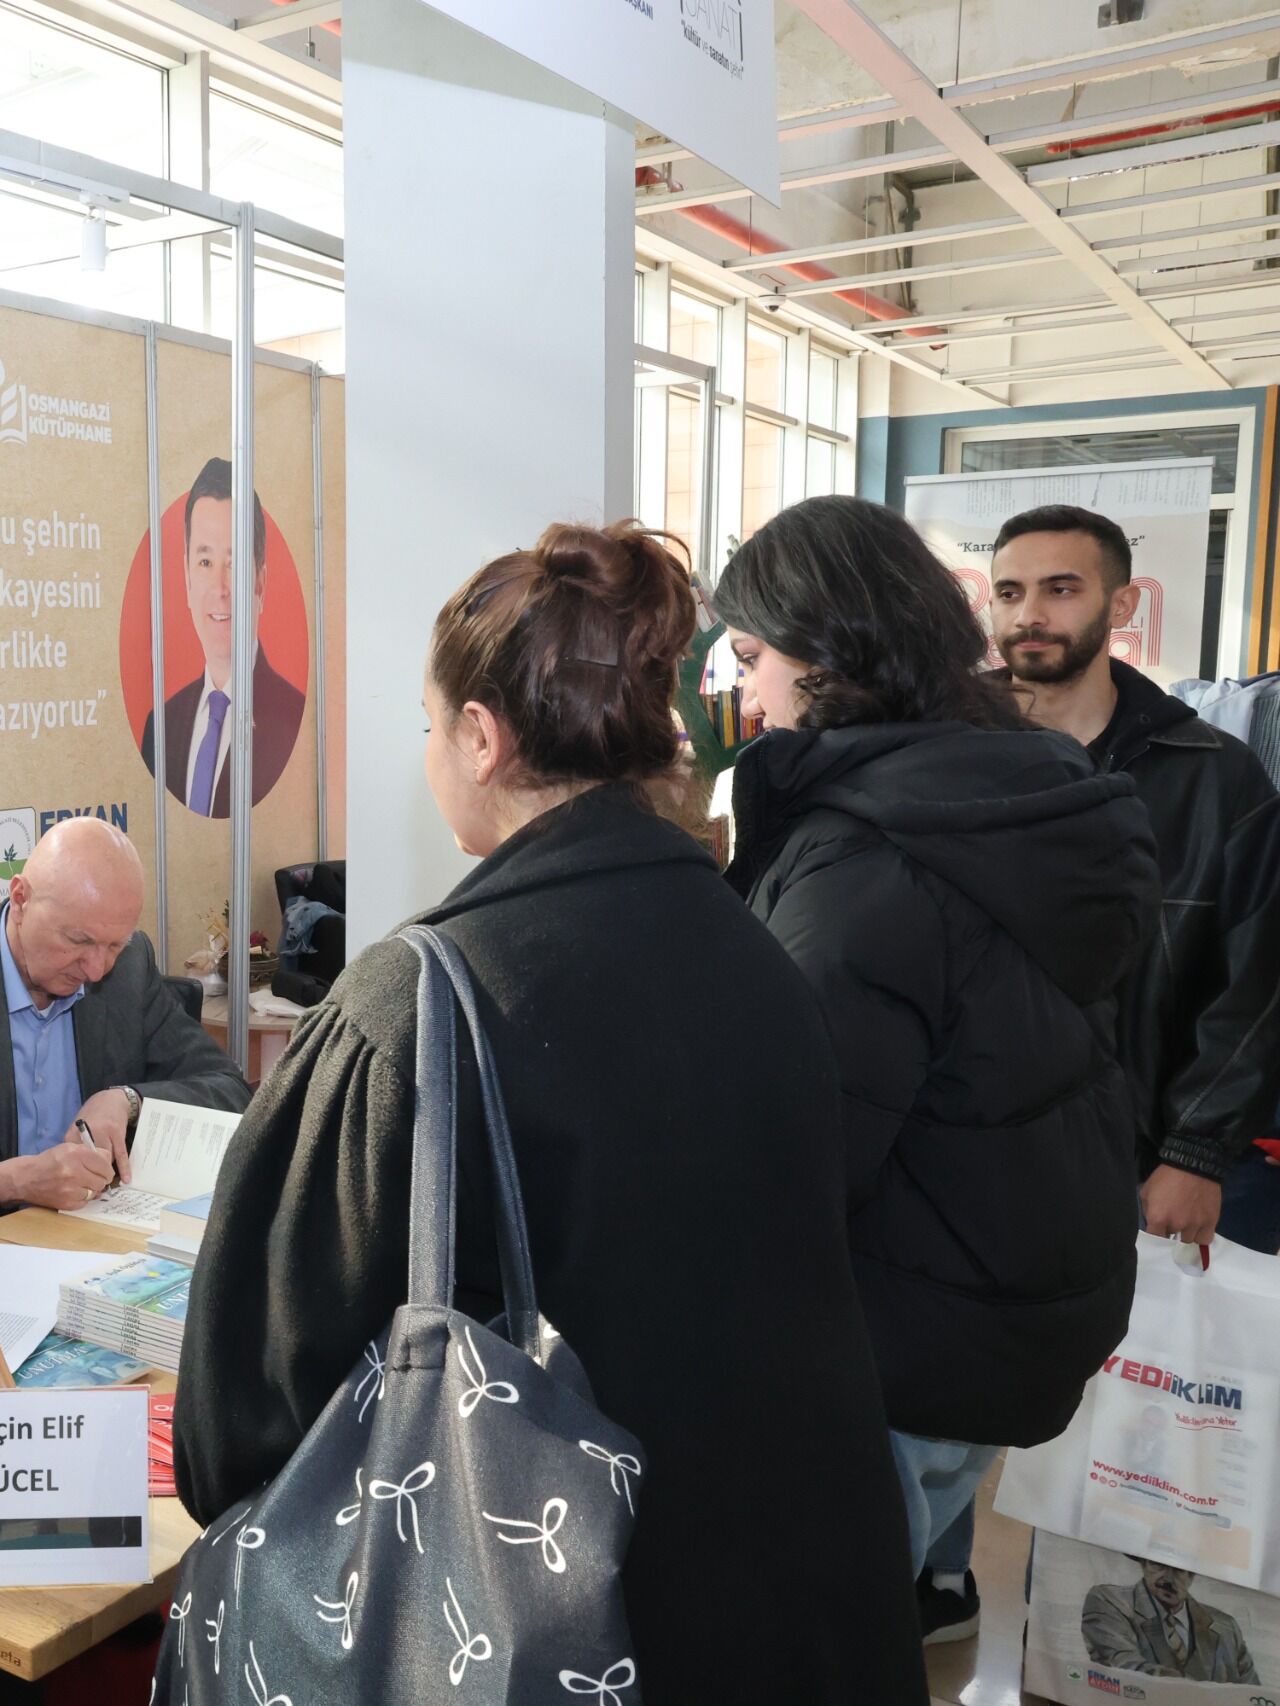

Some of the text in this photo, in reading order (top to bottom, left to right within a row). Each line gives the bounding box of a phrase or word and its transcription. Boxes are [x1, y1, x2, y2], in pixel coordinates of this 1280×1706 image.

[624, 0, 654, 20] ŞKANI
[28, 393, 111, 422] OSMANGAZİ
[28, 413, 113, 444] KÜTÜPHANE
[22, 510, 101, 556] şehrin
[17, 1342, 89, 1380] UNUTMA
[42, 1415, 85, 1440] Elif
[1092, 1459, 1219, 1507] www.yediiklim.com.tr
